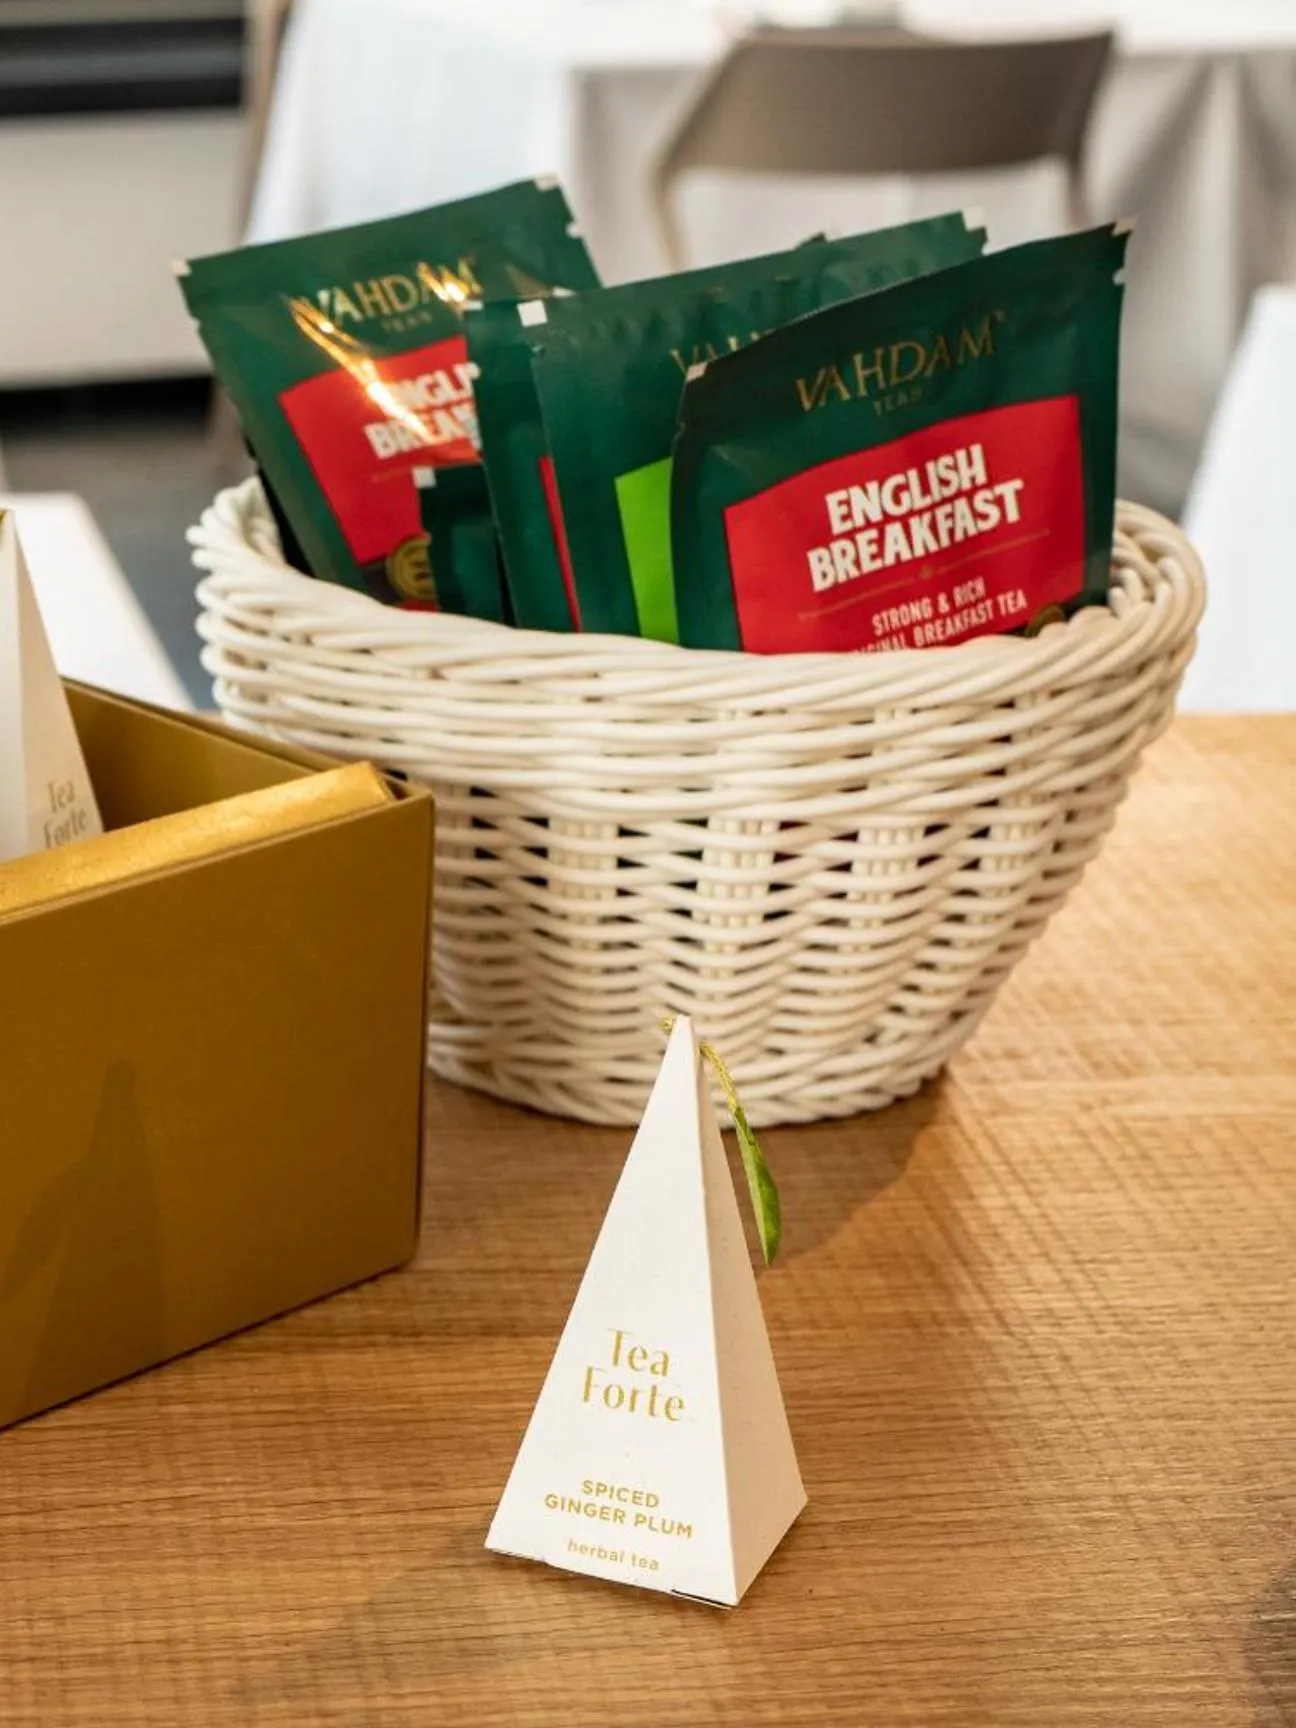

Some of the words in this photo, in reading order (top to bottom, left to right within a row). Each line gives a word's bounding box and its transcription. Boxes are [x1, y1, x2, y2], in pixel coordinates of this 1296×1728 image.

[795, 315, 997, 412] VAHDAM
[825, 443, 988, 536] ENGLISH
[807, 480, 1024, 593] BREAKFAST
[871, 597, 933, 636] STRONG
[937, 593, 950, 613] &
[952, 576, 986, 608] RICH
[912, 600, 995, 648] BREAKFAST
[997, 588, 1028, 616] TEA
[605, 1327, 670, 1377] Tea
[544, 1494, 626, 1525] GINGER
[634, 1513, 693, 1539] PLUM
[582, 1480, 660, 1508] SPICED
[567, 1539, 625, 1564] herbal
[630, 1553, 660, 1571] tea
